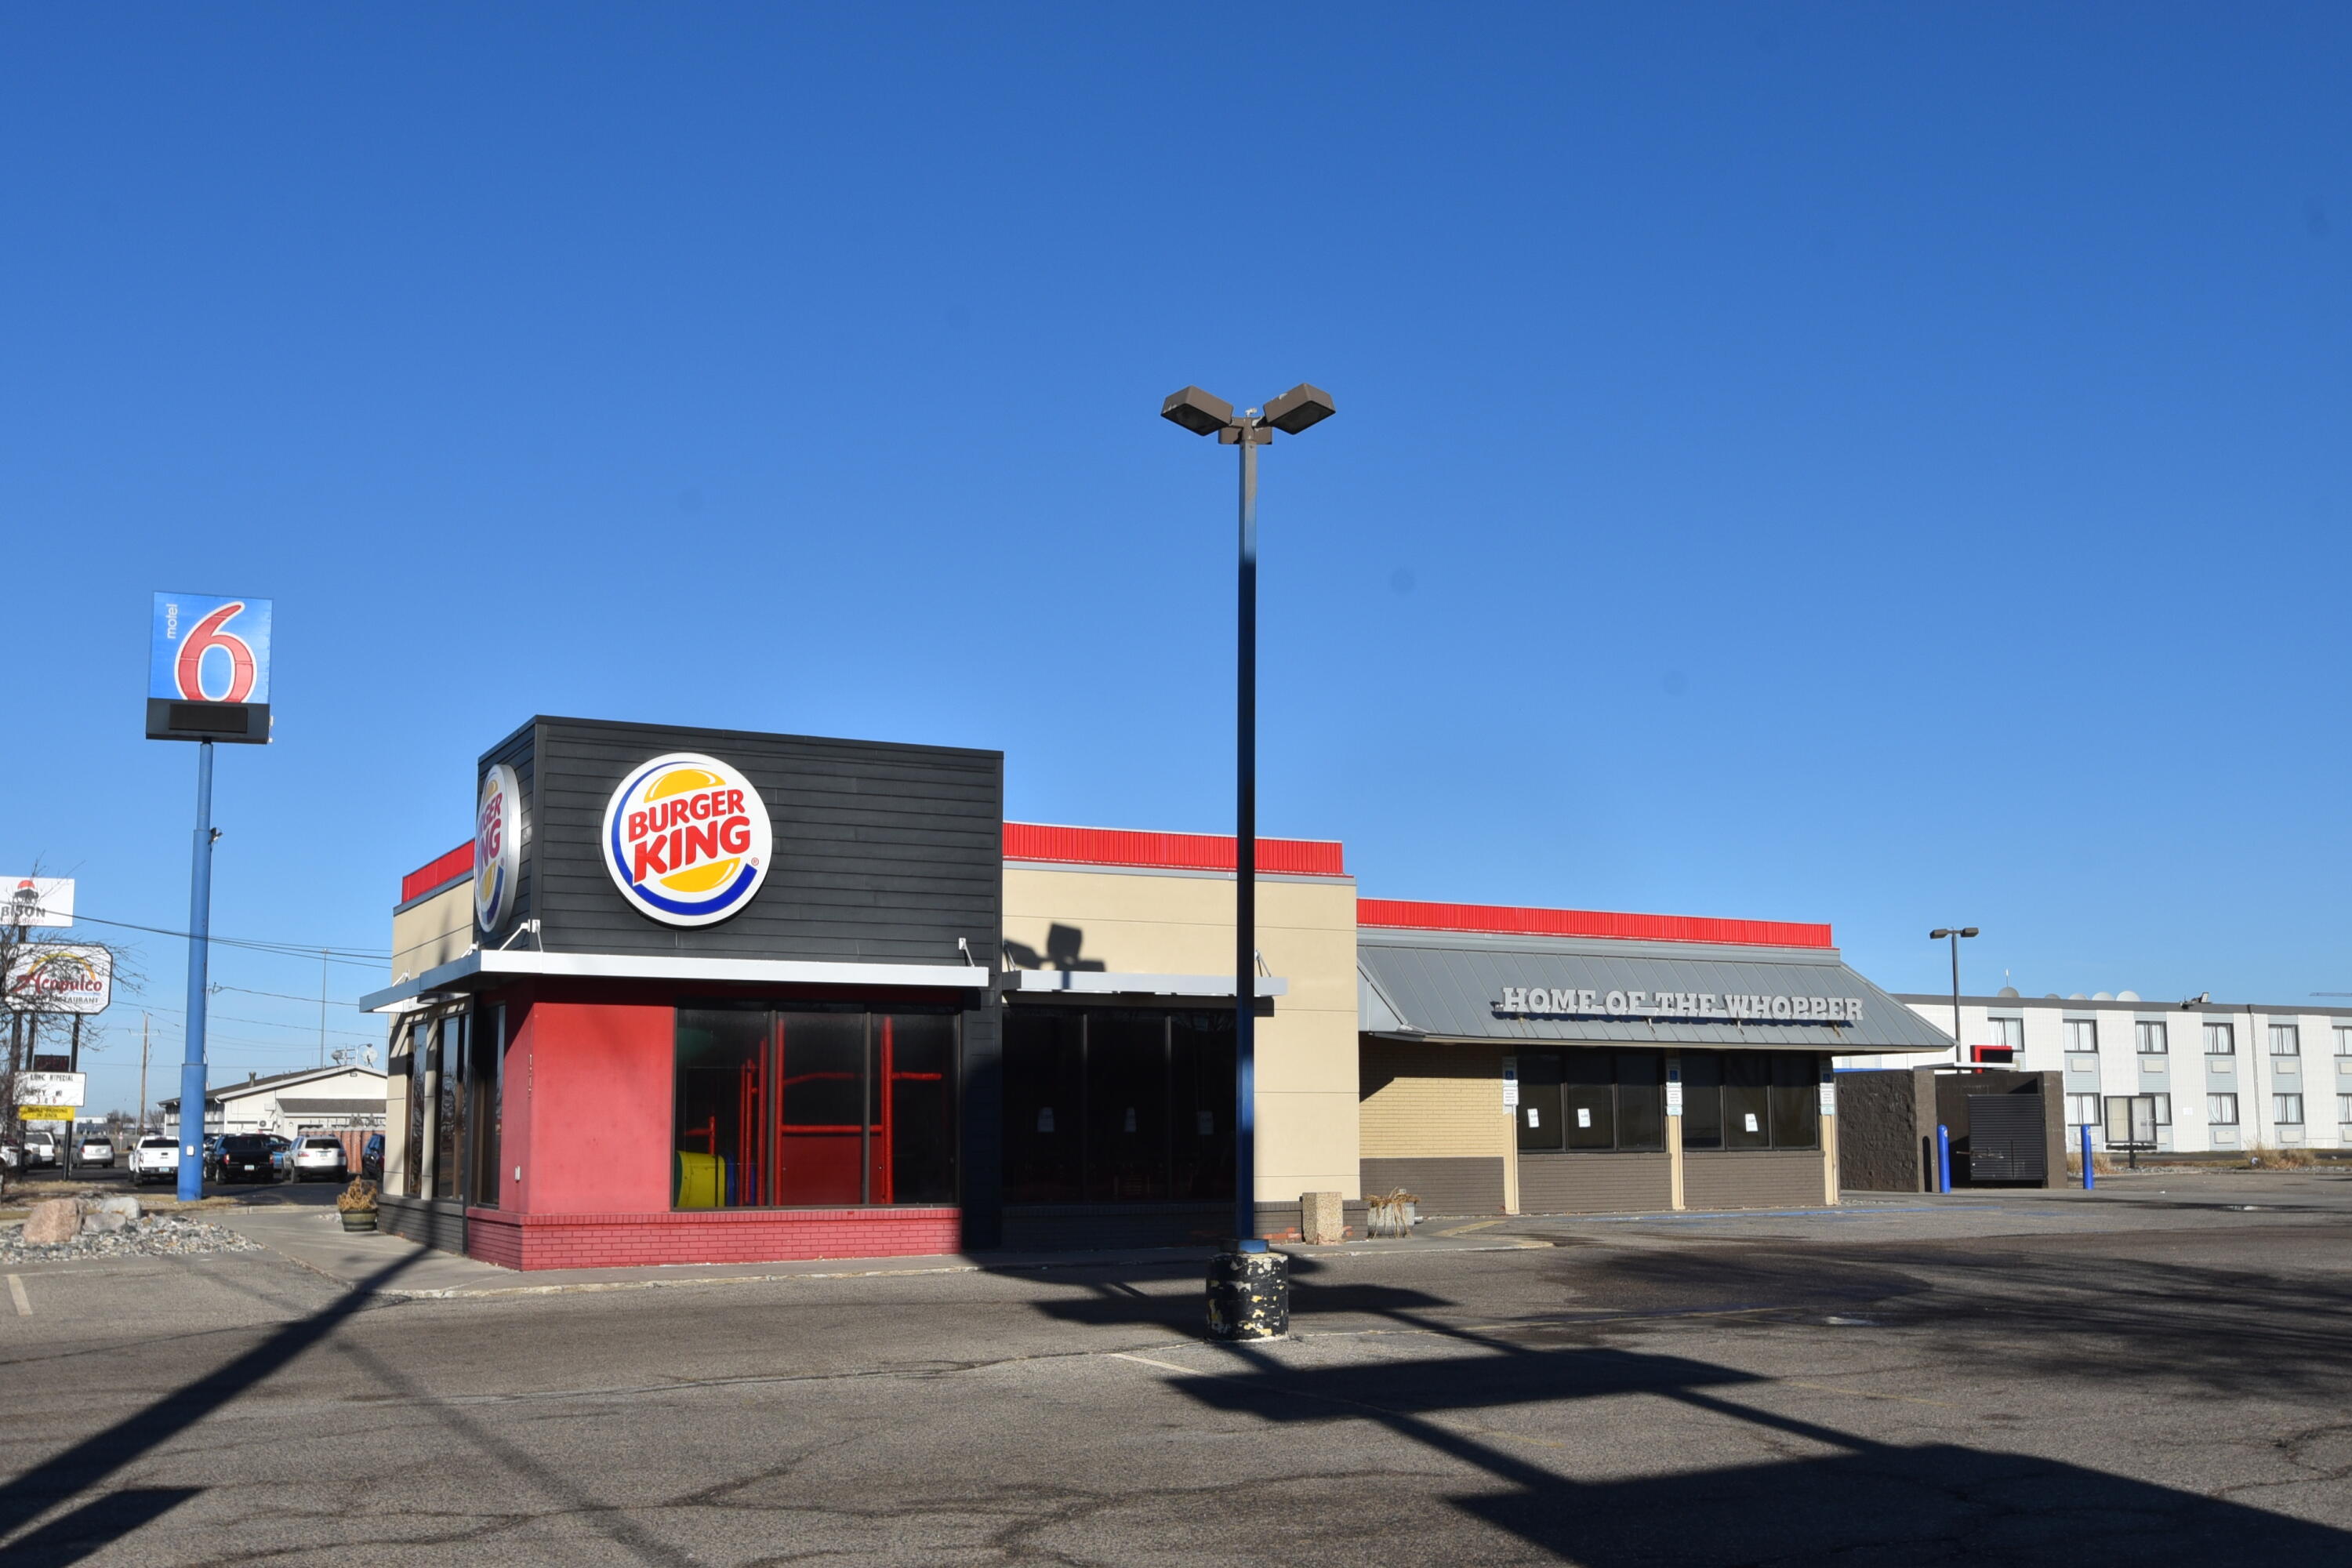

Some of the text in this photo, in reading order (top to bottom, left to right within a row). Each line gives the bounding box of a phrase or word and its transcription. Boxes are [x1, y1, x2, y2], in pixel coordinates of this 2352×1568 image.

[165, 601, 257, 702] motel 6
[477, 792, 503, 836] RGER
[628, 789, 746, 844] BURGER
[477, 818, 502, 873] NG
[633, 815, 750, 884] KING
[1, 906, 45, 917] BISON
[12, 966, 103, 994] Acapulco
[1503, 987, 1864, 1021] HOME OF THE WHOPPER
